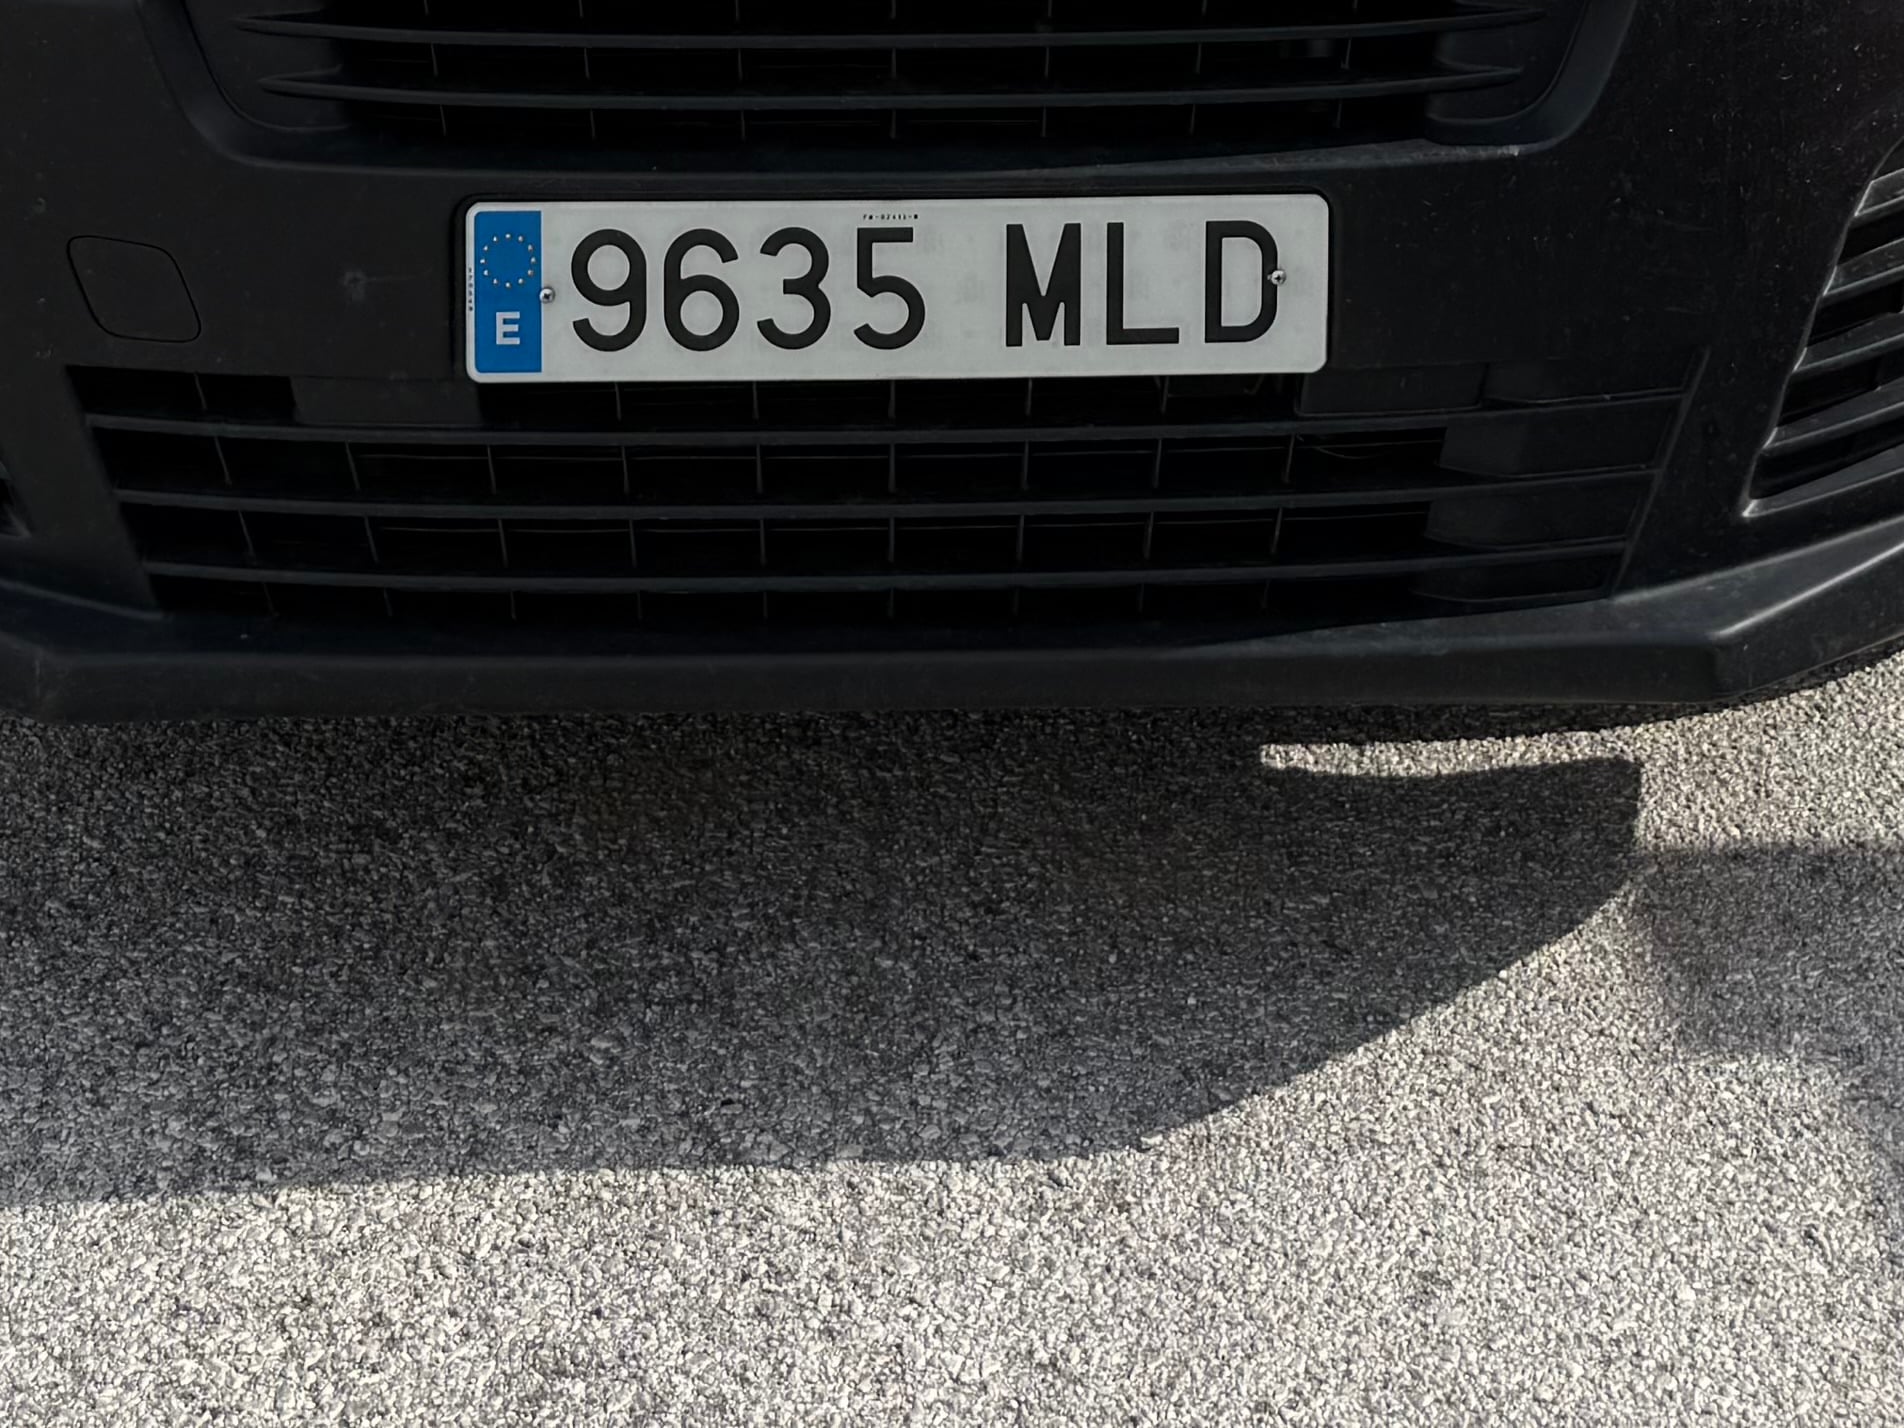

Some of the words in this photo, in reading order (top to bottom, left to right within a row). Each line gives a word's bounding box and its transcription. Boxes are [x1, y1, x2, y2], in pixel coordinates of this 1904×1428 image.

[495, 311, 521, 345] E
[570, 226, 926, 353] 9635
[1005, 220, 1282, 348] MLD
